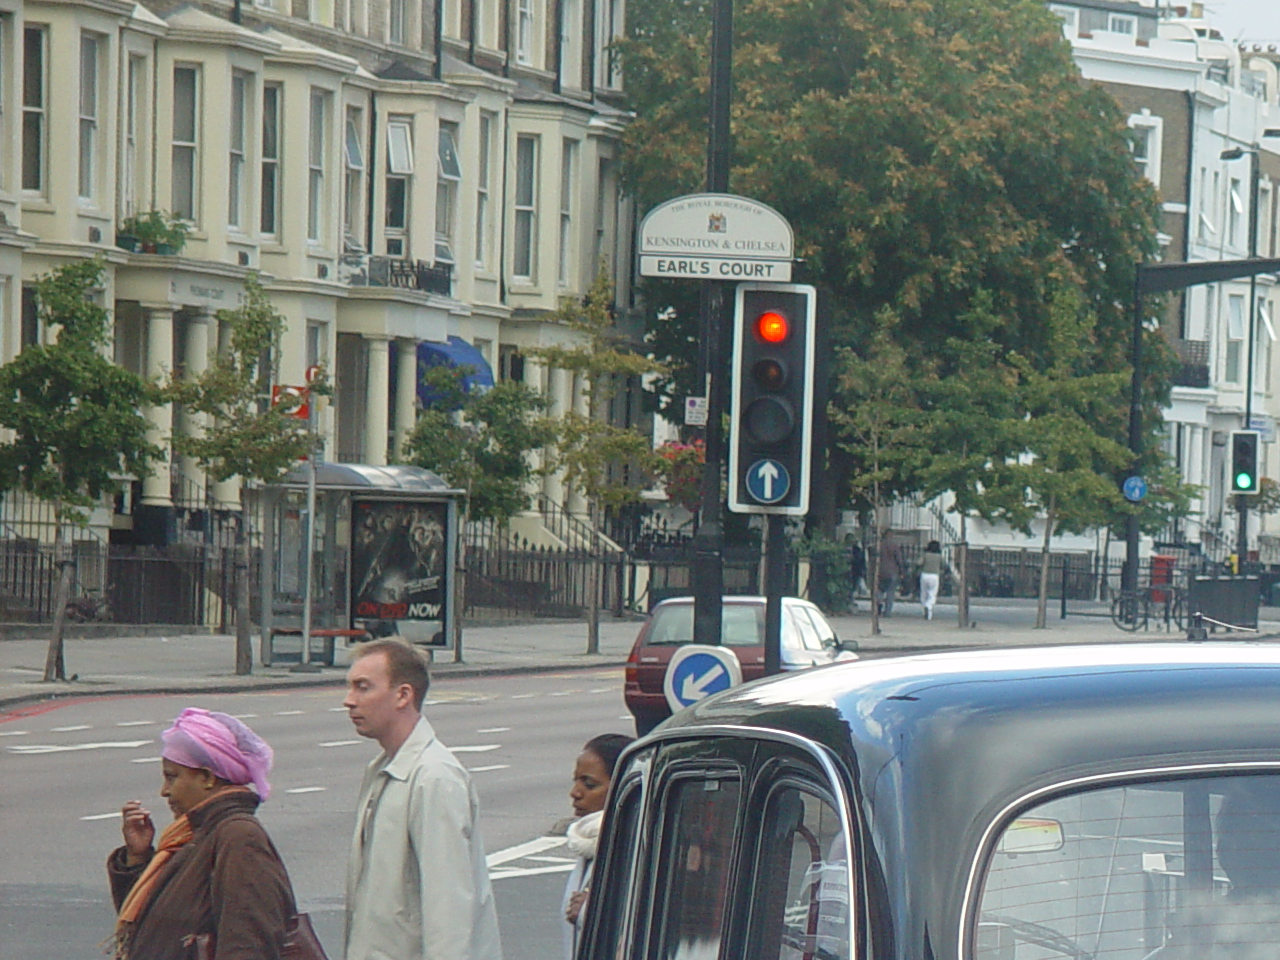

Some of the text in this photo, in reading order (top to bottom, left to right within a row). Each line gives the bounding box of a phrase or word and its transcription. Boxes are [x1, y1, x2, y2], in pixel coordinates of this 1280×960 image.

[671, 204, 685, 213] THE
[687, 200, 712, 209] ROYAL
[714, 200, 751, 212] BOROUGH
[646, 236, 786, 252] KENSINGTON & CHELSEA
[657, 260, 775, 277] EARL'S COURT
[408, 602, 441, 617] NOW
